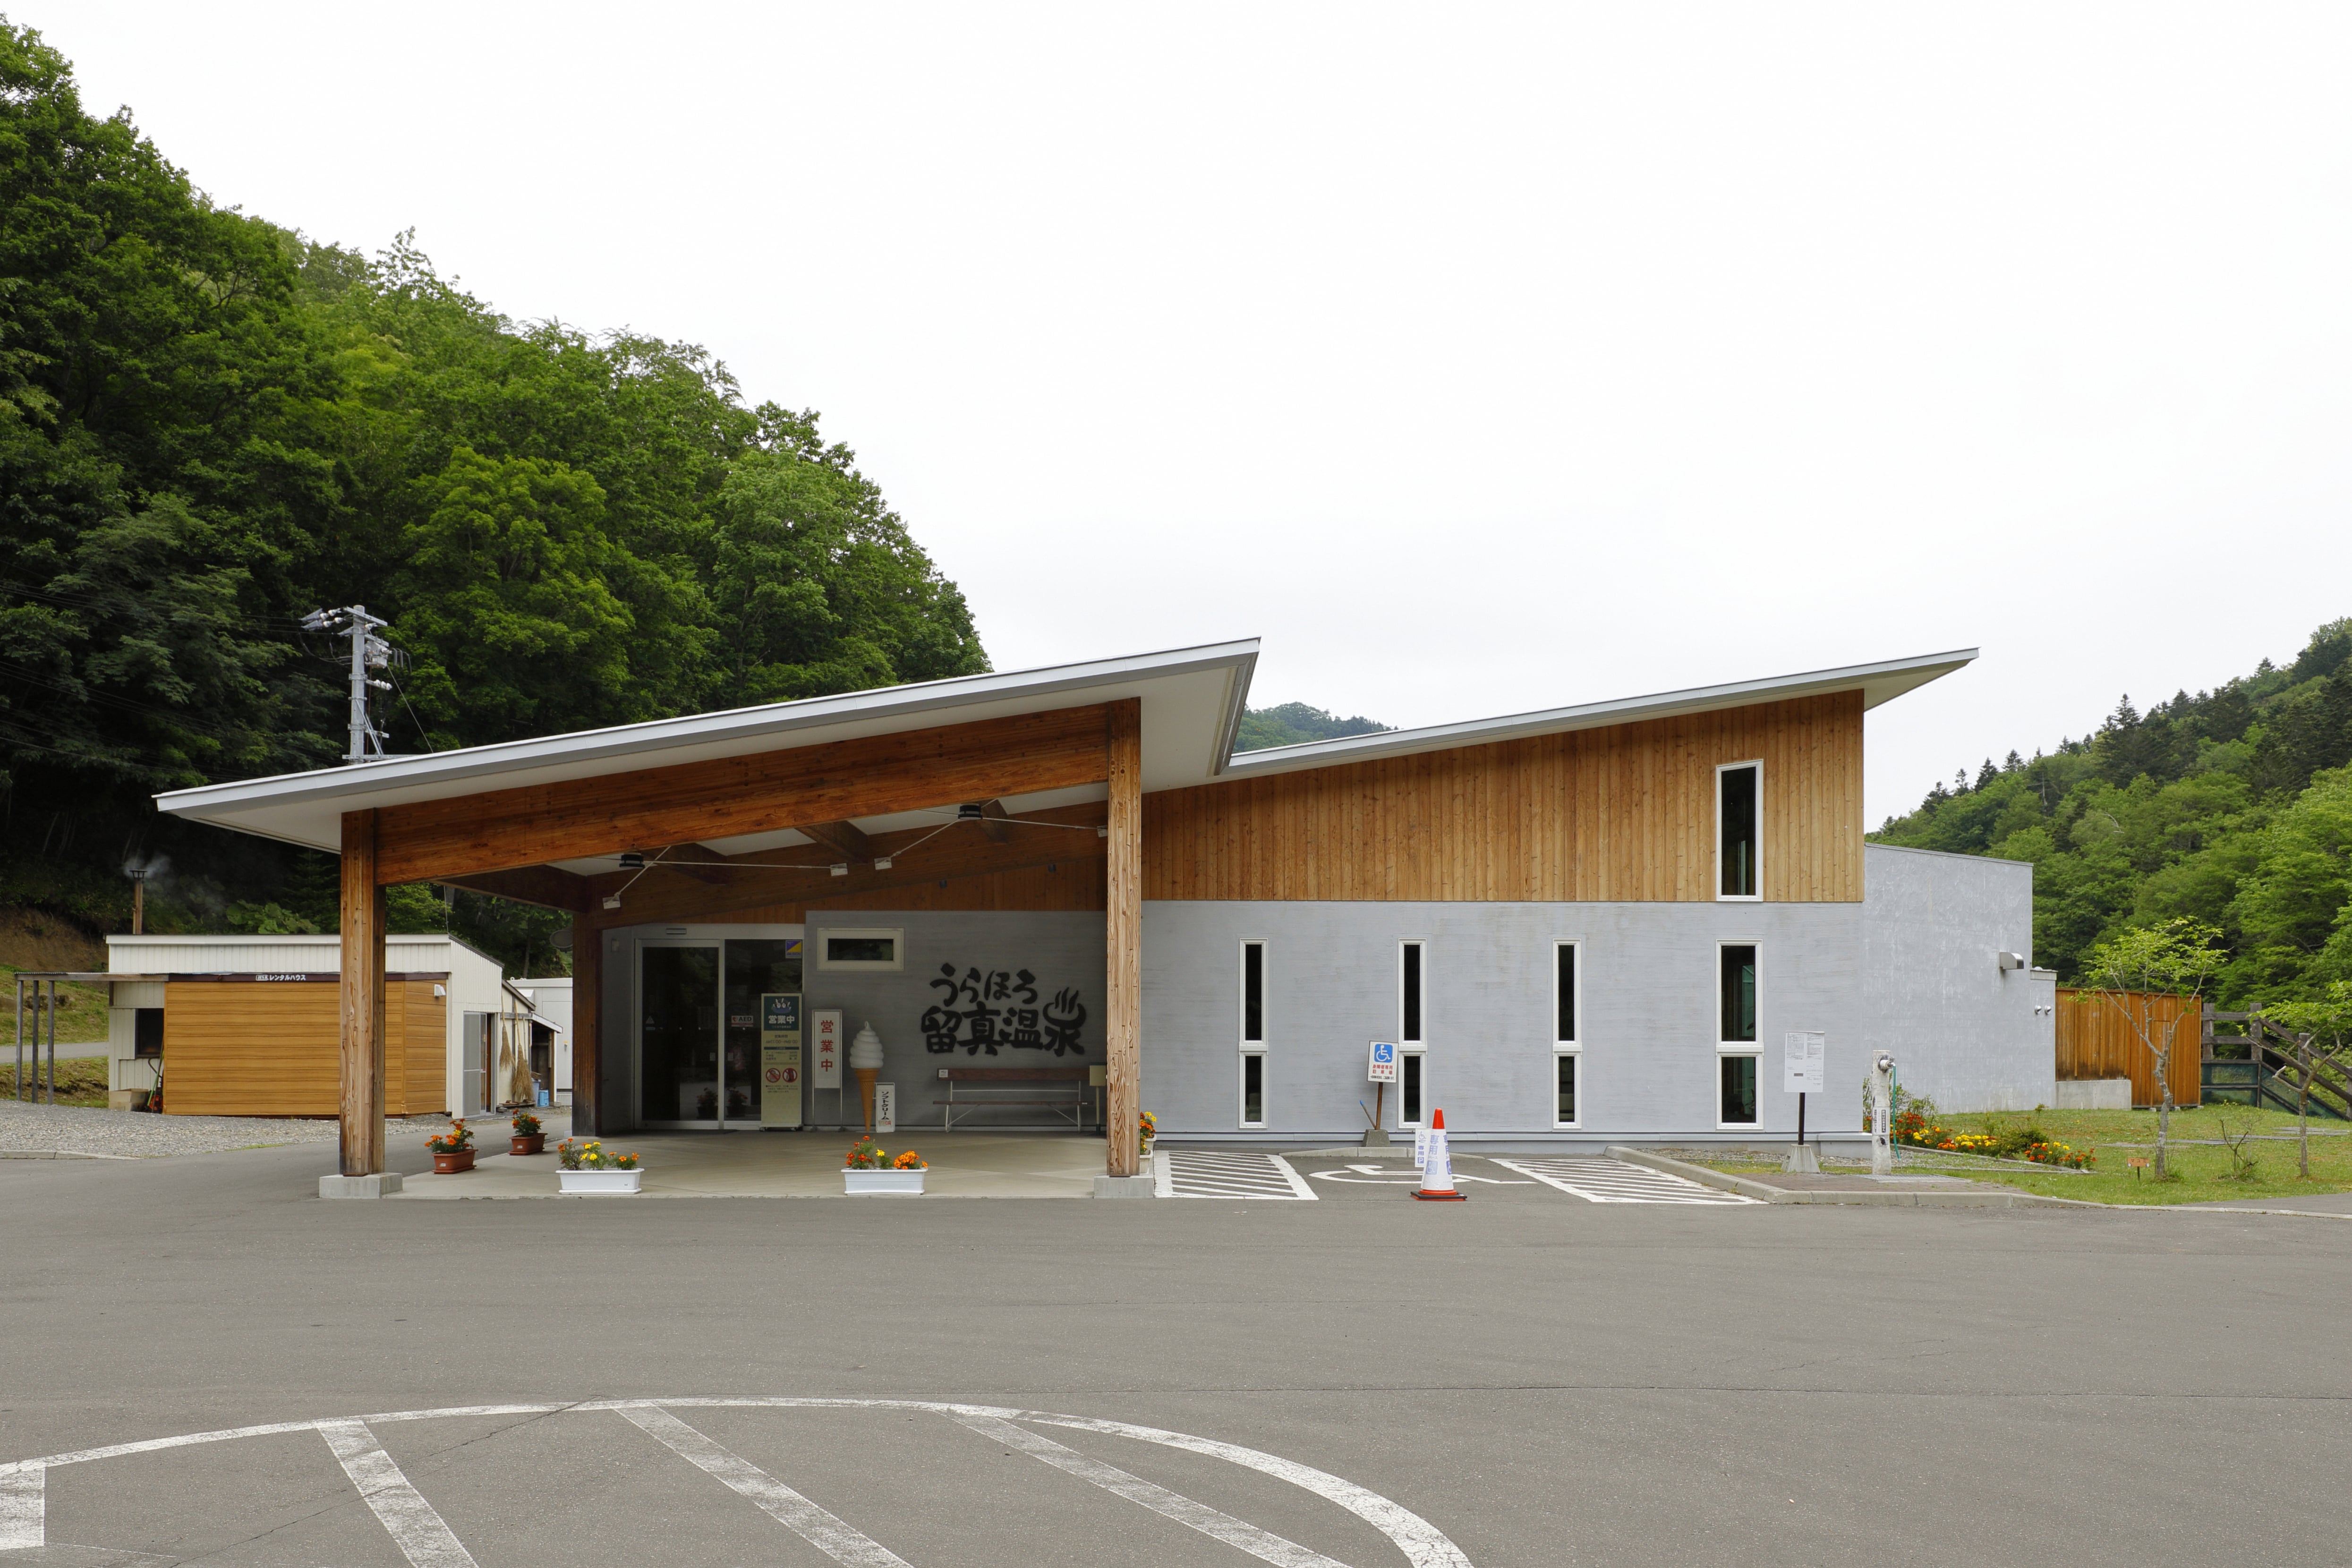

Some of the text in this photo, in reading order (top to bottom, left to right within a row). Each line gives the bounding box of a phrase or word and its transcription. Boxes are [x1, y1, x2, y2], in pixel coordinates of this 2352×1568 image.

[930, 963, 1038, 1007] うらほろ
[768, 1015, 795, 1024] 営業中
[820, 1020, 834, 1072] 営業中
[1430, 1134, 1440, 1155] 専用
